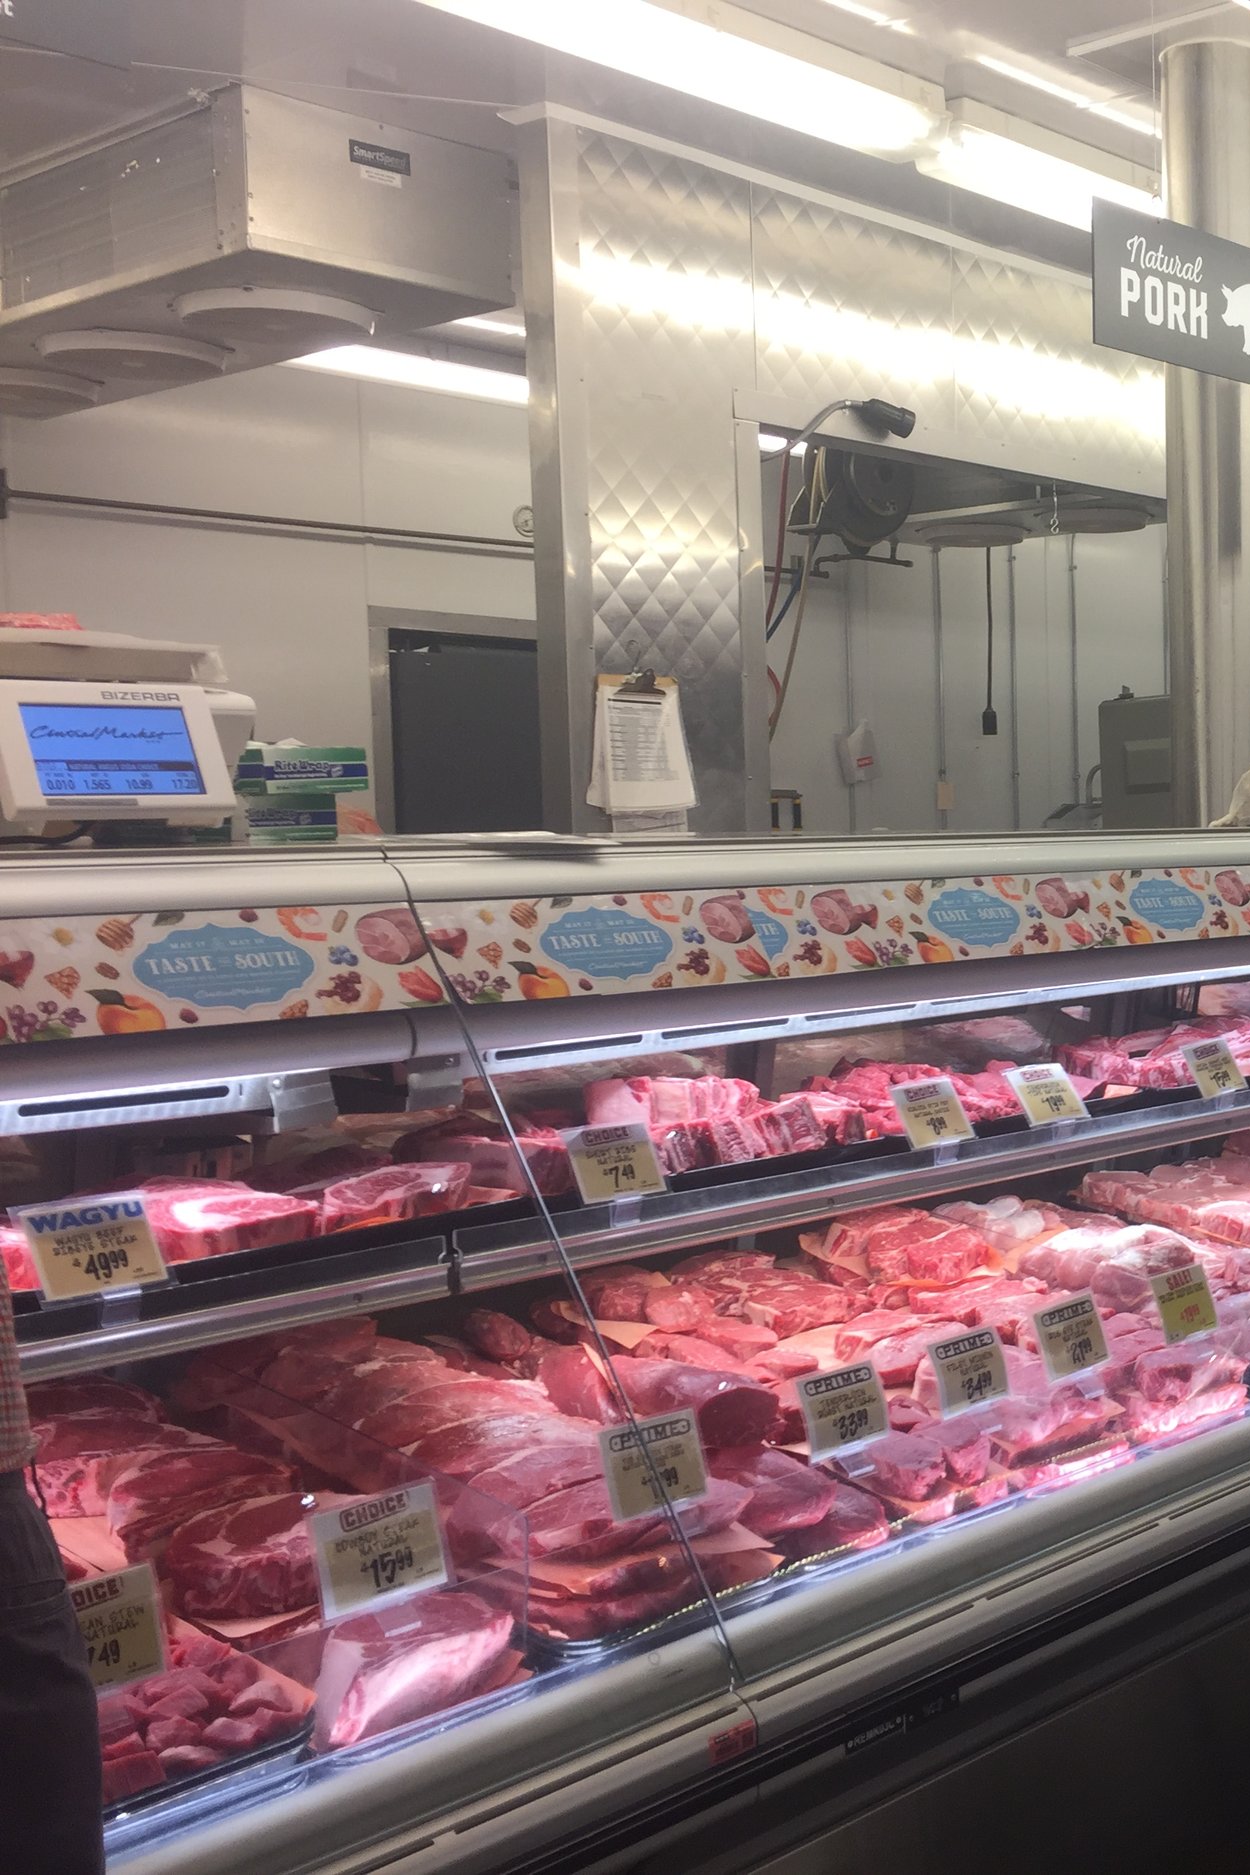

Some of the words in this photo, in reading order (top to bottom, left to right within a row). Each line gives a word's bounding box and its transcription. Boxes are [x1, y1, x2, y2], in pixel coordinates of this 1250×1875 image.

[1126, 235, 1203, 283] Natural
[1120, 267, 1208, 339] PORK
[100, 691, 181, 701] BIZERBA
[547, 933, 602, 950] TASTE
[145, 955, 216, 975] TASTE
[234, 951, 300, 969] SOUTH
[585, 1126, 629, 1143] CHOICE
[27, 1201, 144, 1234] WAGYU
[100, 1234, 138, 1249] STEAK
[943, 1334, 986, 1357] PRIME
[813, 1369, 862, 1393] PRIME
[621, 1420, 683, 1450] PRIME
[343, 1493, 407, 1528] CHOICE
